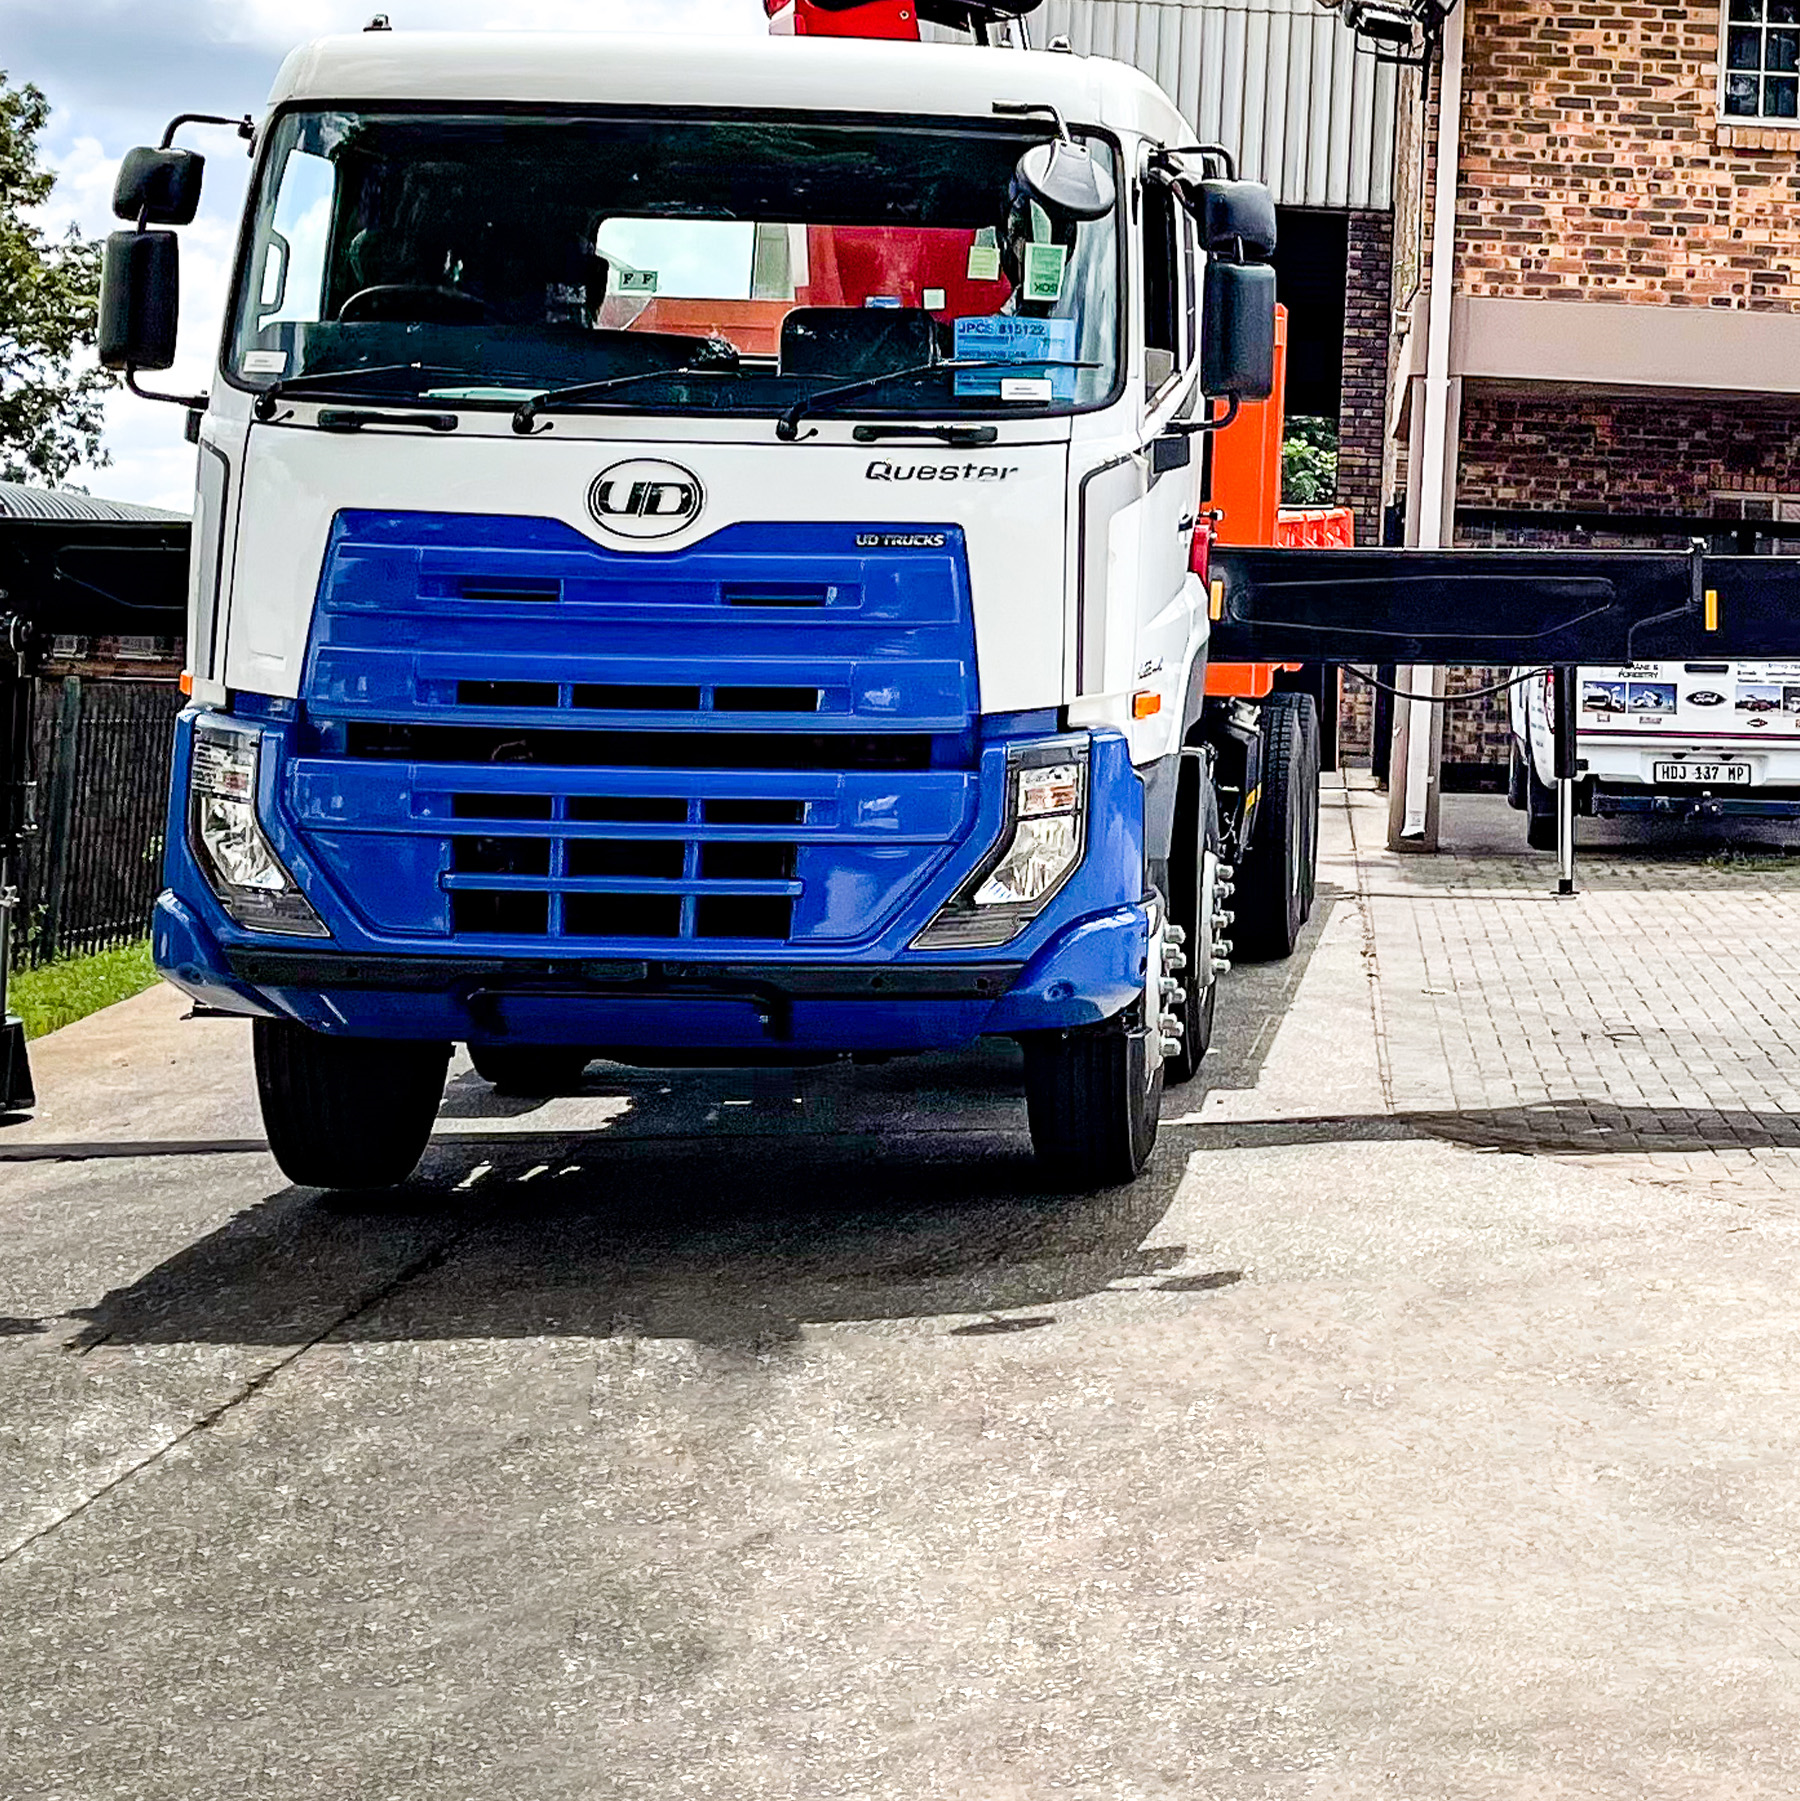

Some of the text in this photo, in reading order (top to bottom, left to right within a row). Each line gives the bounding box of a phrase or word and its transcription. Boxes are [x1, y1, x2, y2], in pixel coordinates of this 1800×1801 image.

[865, 460, 1019, 482] Quester
[597, 480, 697, 517] UD
[856, 534, 945, 546] UD TRUCKS
[1662, 764, 1687, 780] HDJ
[1728, 766, 1744, 781] MP
